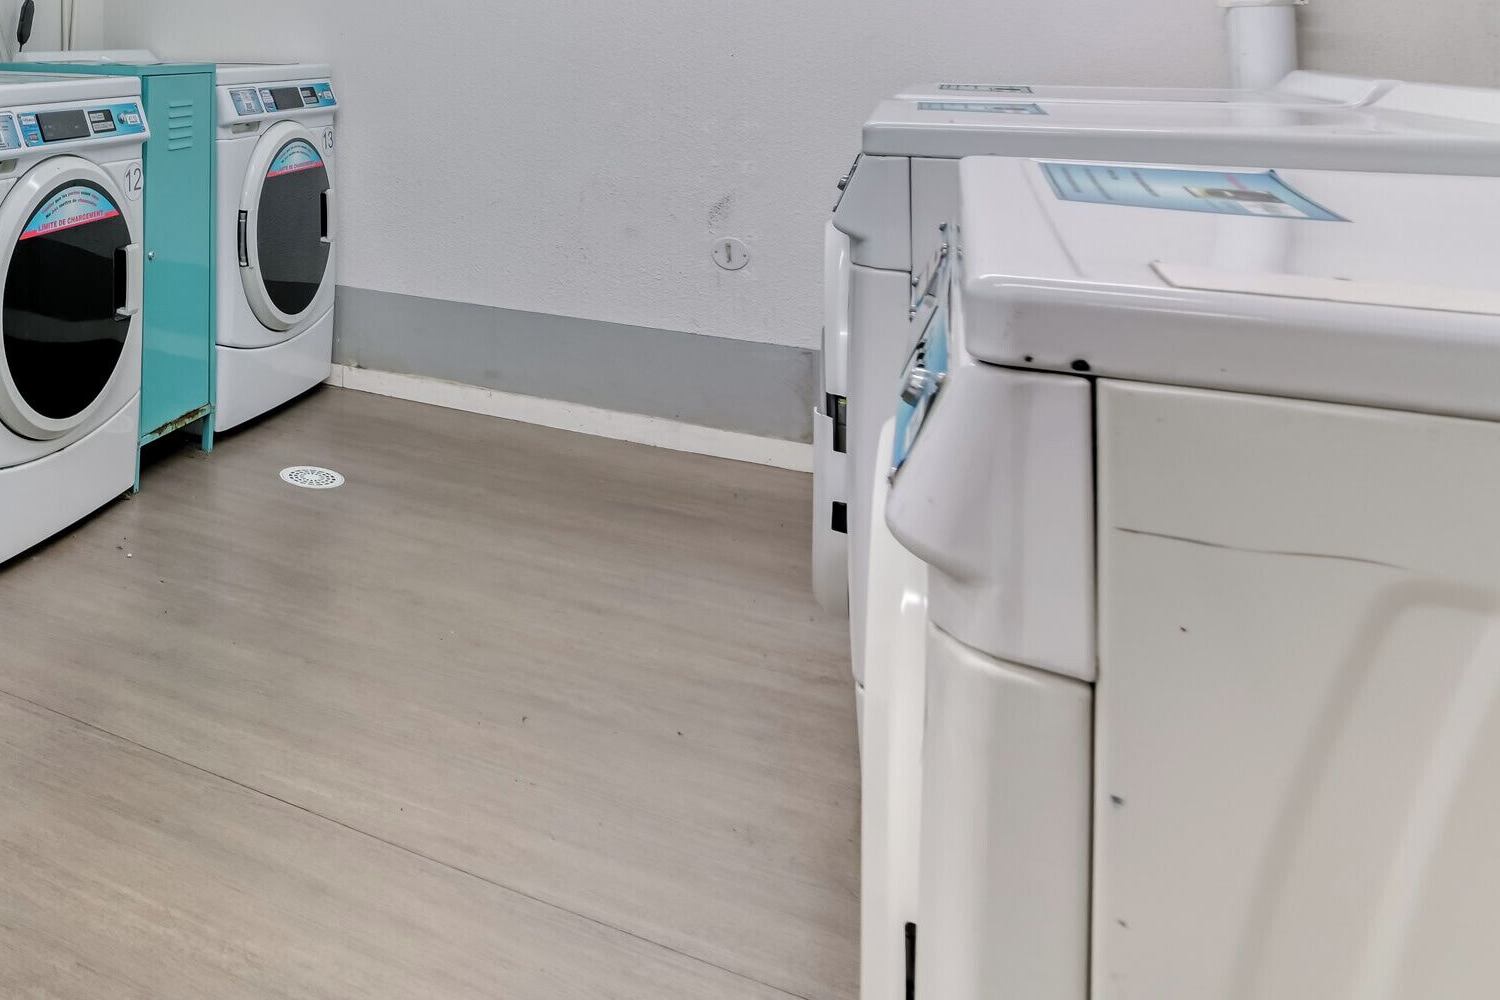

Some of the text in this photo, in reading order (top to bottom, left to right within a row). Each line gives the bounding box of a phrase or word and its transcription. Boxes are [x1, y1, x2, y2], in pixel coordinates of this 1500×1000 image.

[323, 130, 334, 150] 13
[125, 167, 142, 192] 12
[38, 209, 104, 232] LIMITE DE CHARGEMENT
